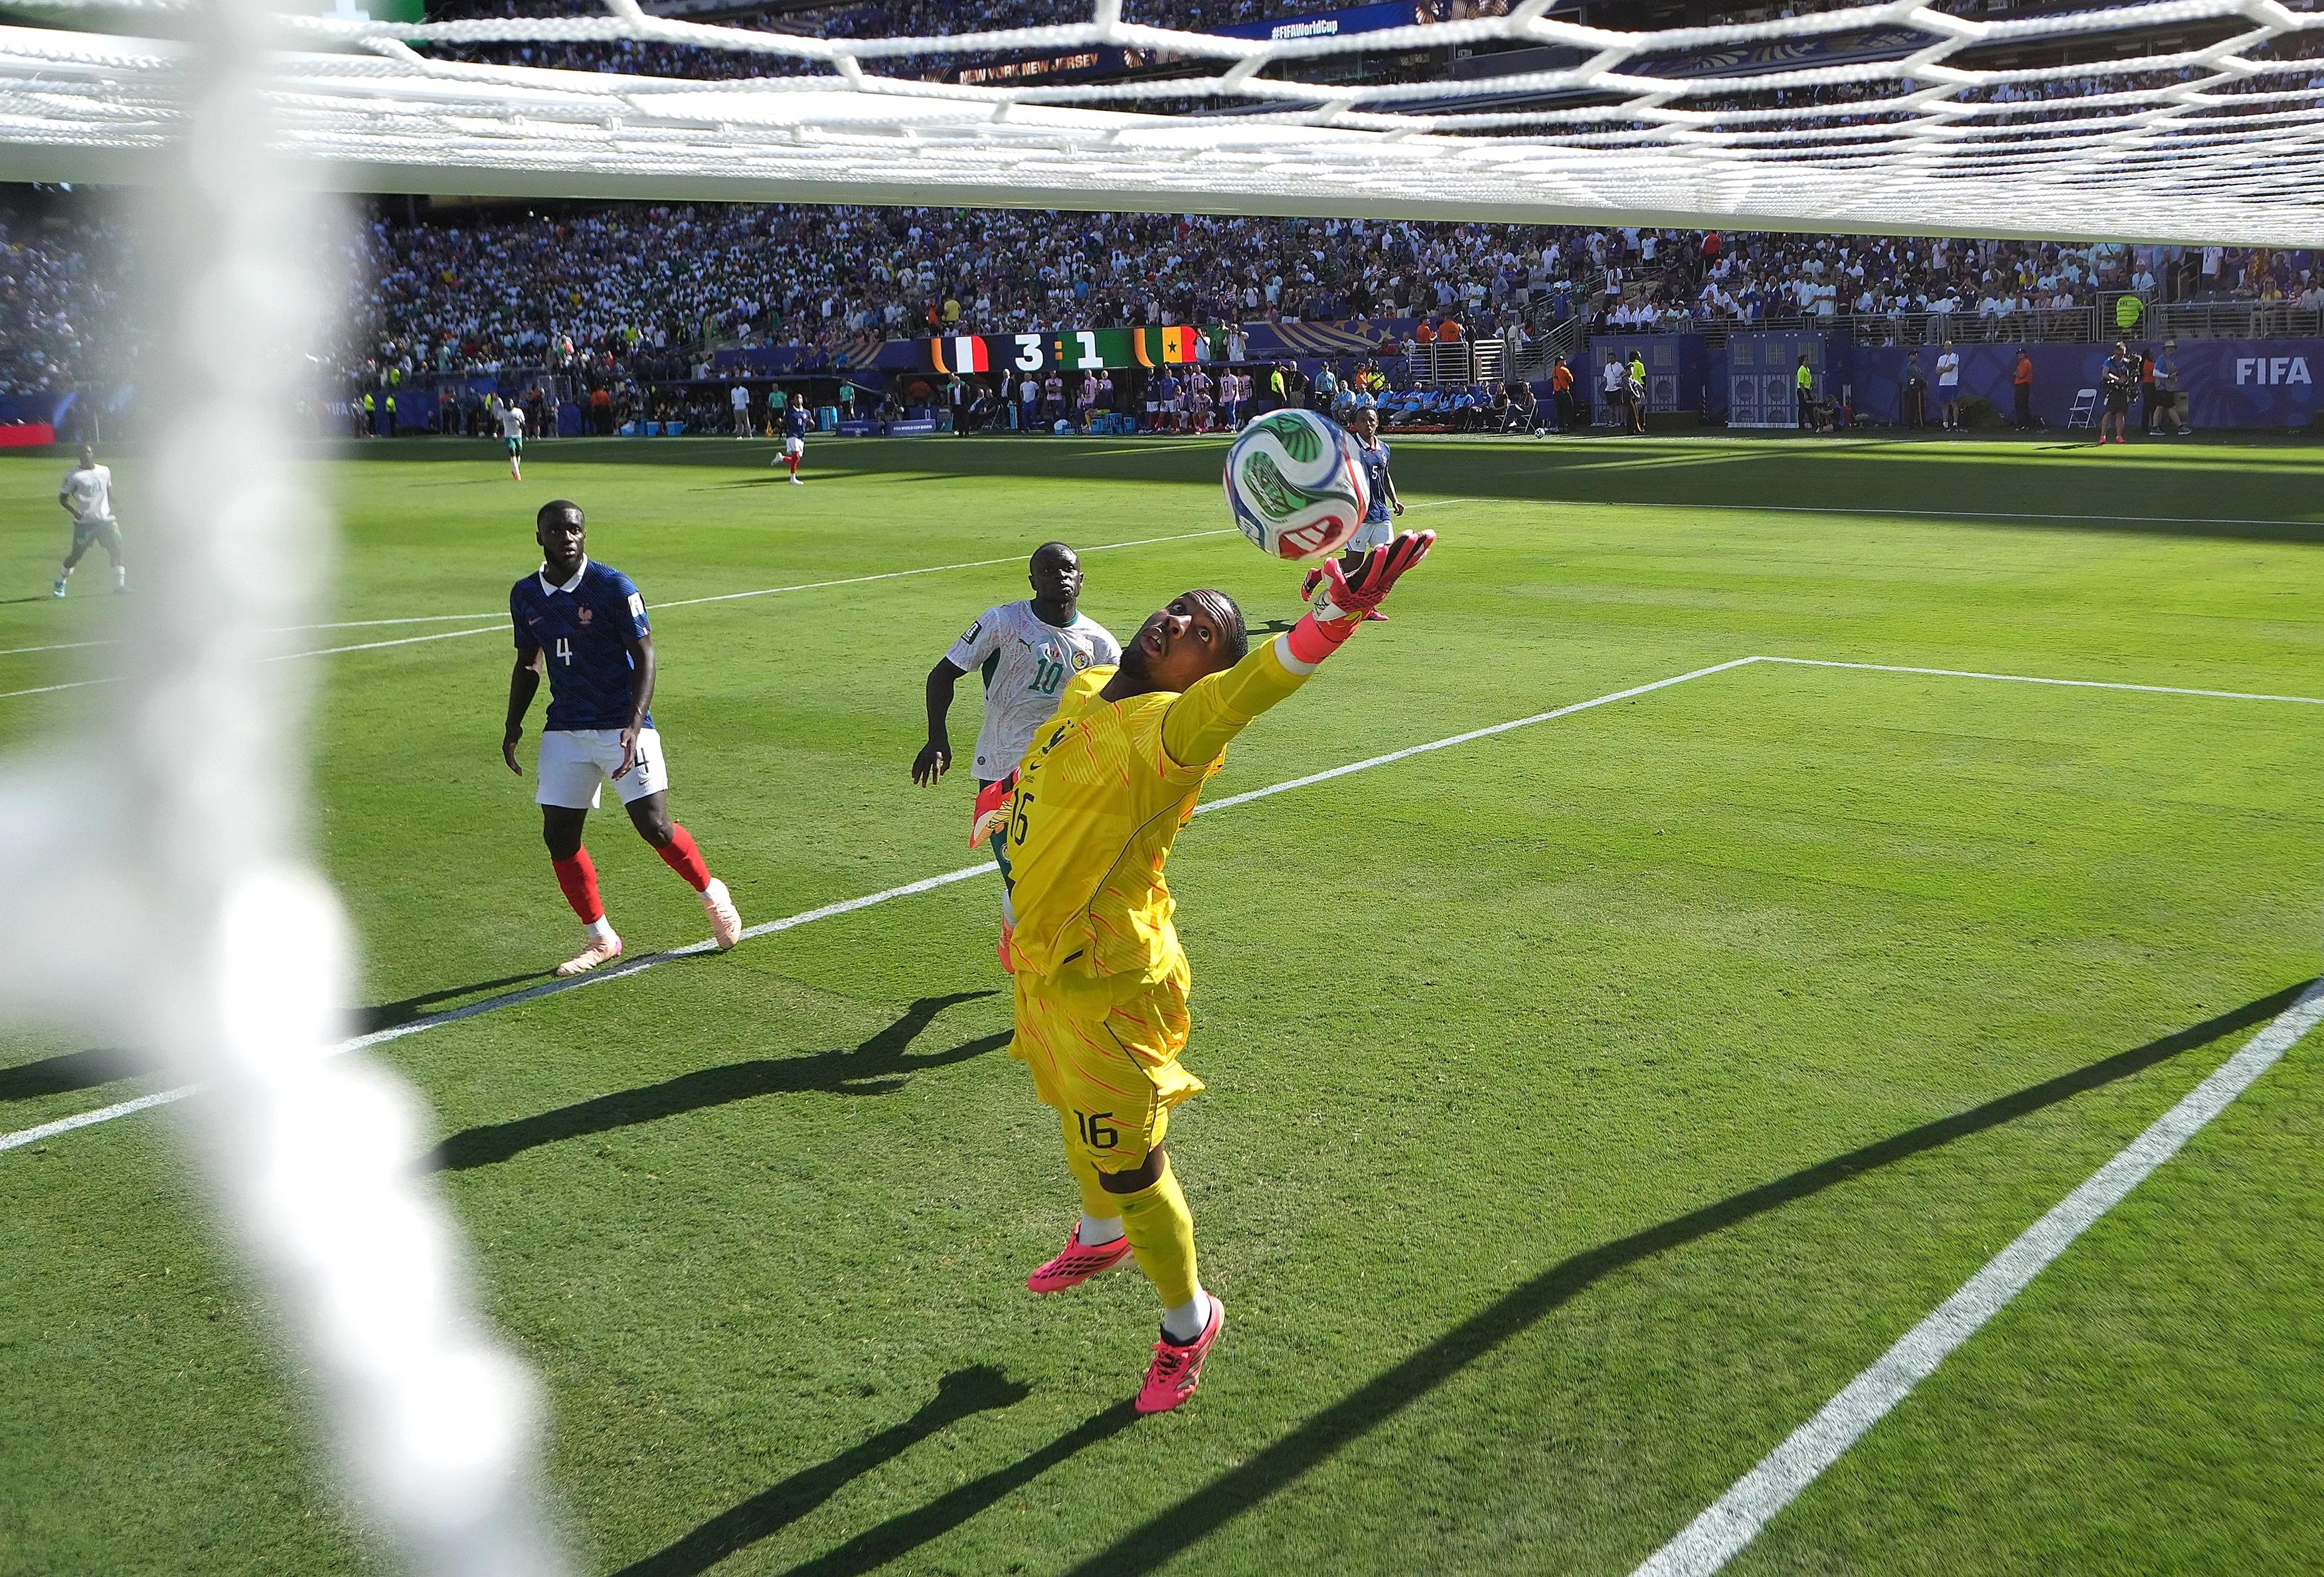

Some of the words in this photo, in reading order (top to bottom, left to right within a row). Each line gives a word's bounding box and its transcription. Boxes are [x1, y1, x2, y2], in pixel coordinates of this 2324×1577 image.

[1272, 19, 1338, 39] #FIFAWorldCup
[959, 68, 986, 84] NEW
[987, 64, 1021, 80] YORK
[1021, 60, 1050, 76] NEW
[1052, 53, 1100, 70] JERSEY
[2236, 357, 2313, 385] FIFA
[1372, 465, 1378, 480] 5
[556, 637, 573, 666] 4
[1029, 658, 1064, 695] 10
[633, 748, 649, 774] 4
[1011, 788, 1035, 846] 16
[1074, 1109, 1118, 1148] 16
